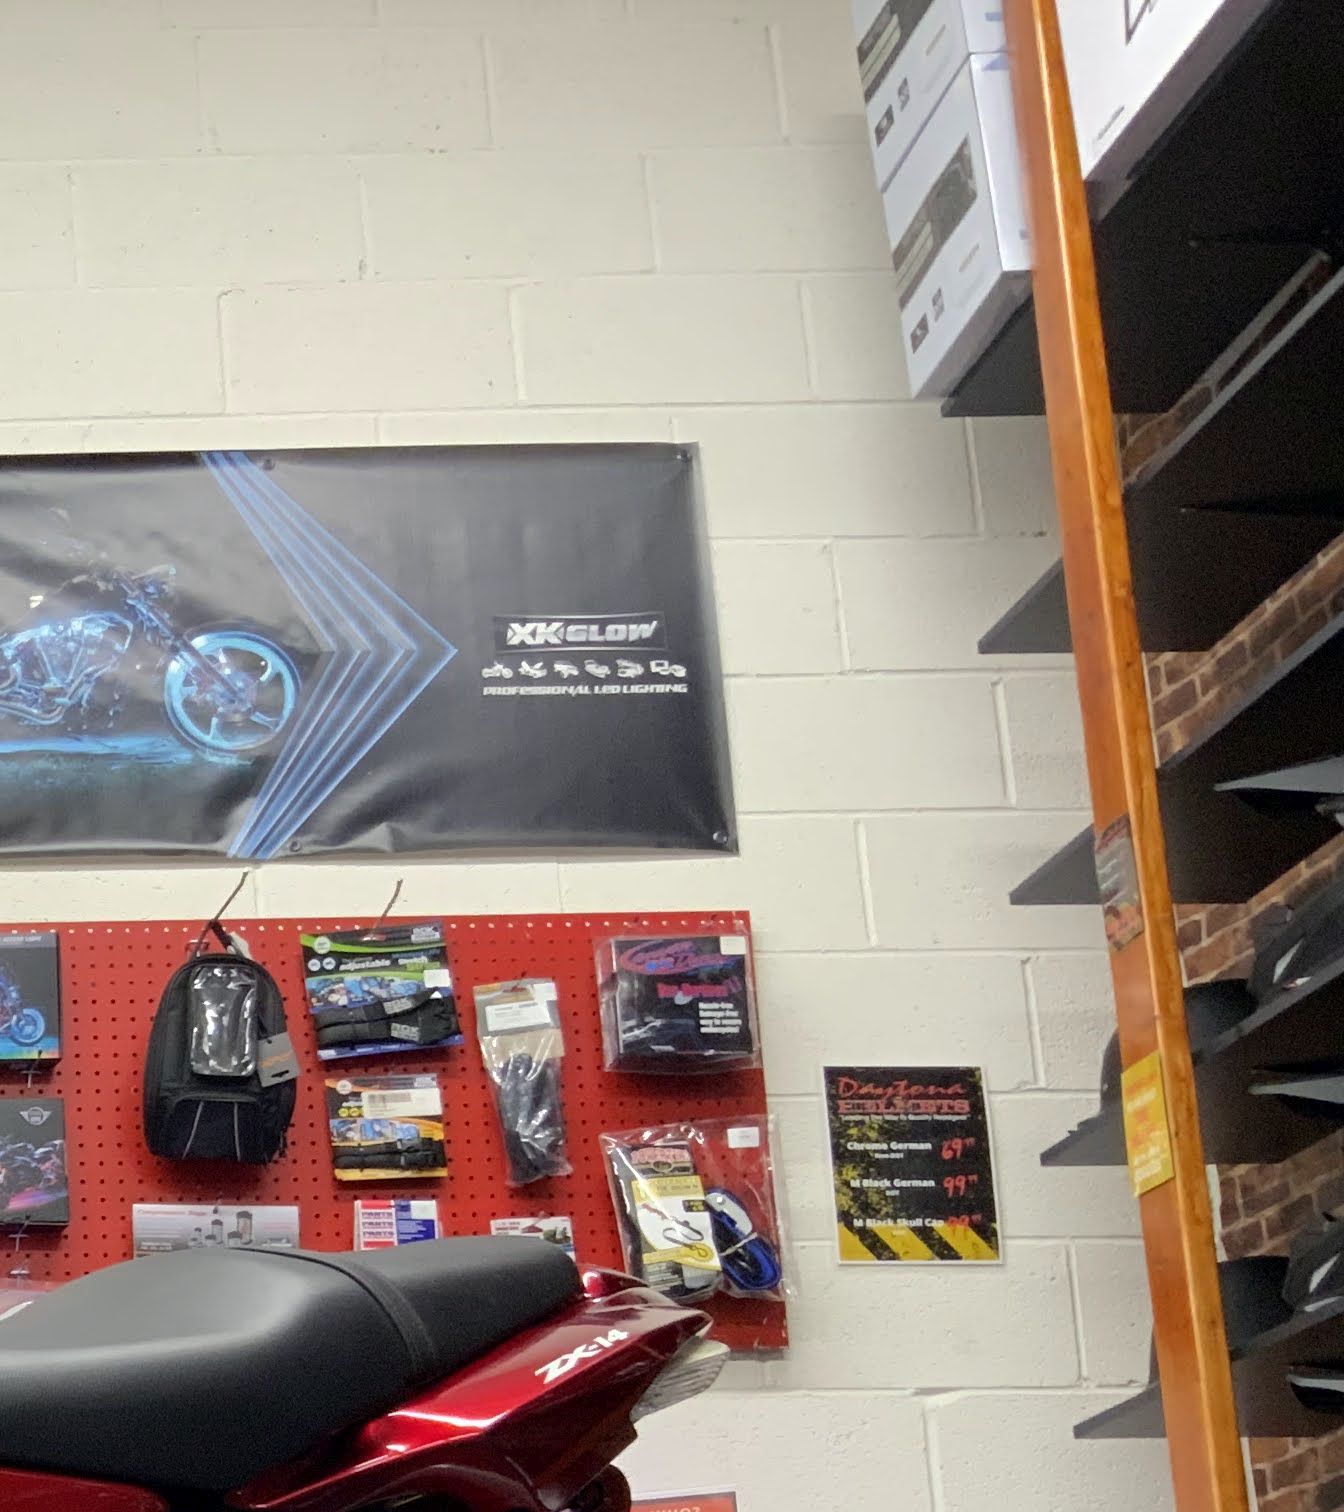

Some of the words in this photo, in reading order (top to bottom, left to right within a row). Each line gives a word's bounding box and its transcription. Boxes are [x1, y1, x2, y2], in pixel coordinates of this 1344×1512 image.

[482, 685, 591, 697] PROFESSIONAL
[593, 685, 621, 694] LED
[622, 683, 689, 694] LIGHTING
[837, 1076, 965, 1099] Daytona
[846, 1141, 888, 1151] Chrome
[889, 1140, 933, 1151] German
[862, 1178, 892, 1188] Black
[893, 1179, 936, 1188] German
[865, 1218, 895, 1228] Black
[896, 1218, 923, 1227] Skull
[534, 1328, 629, 1385] ZX-14
